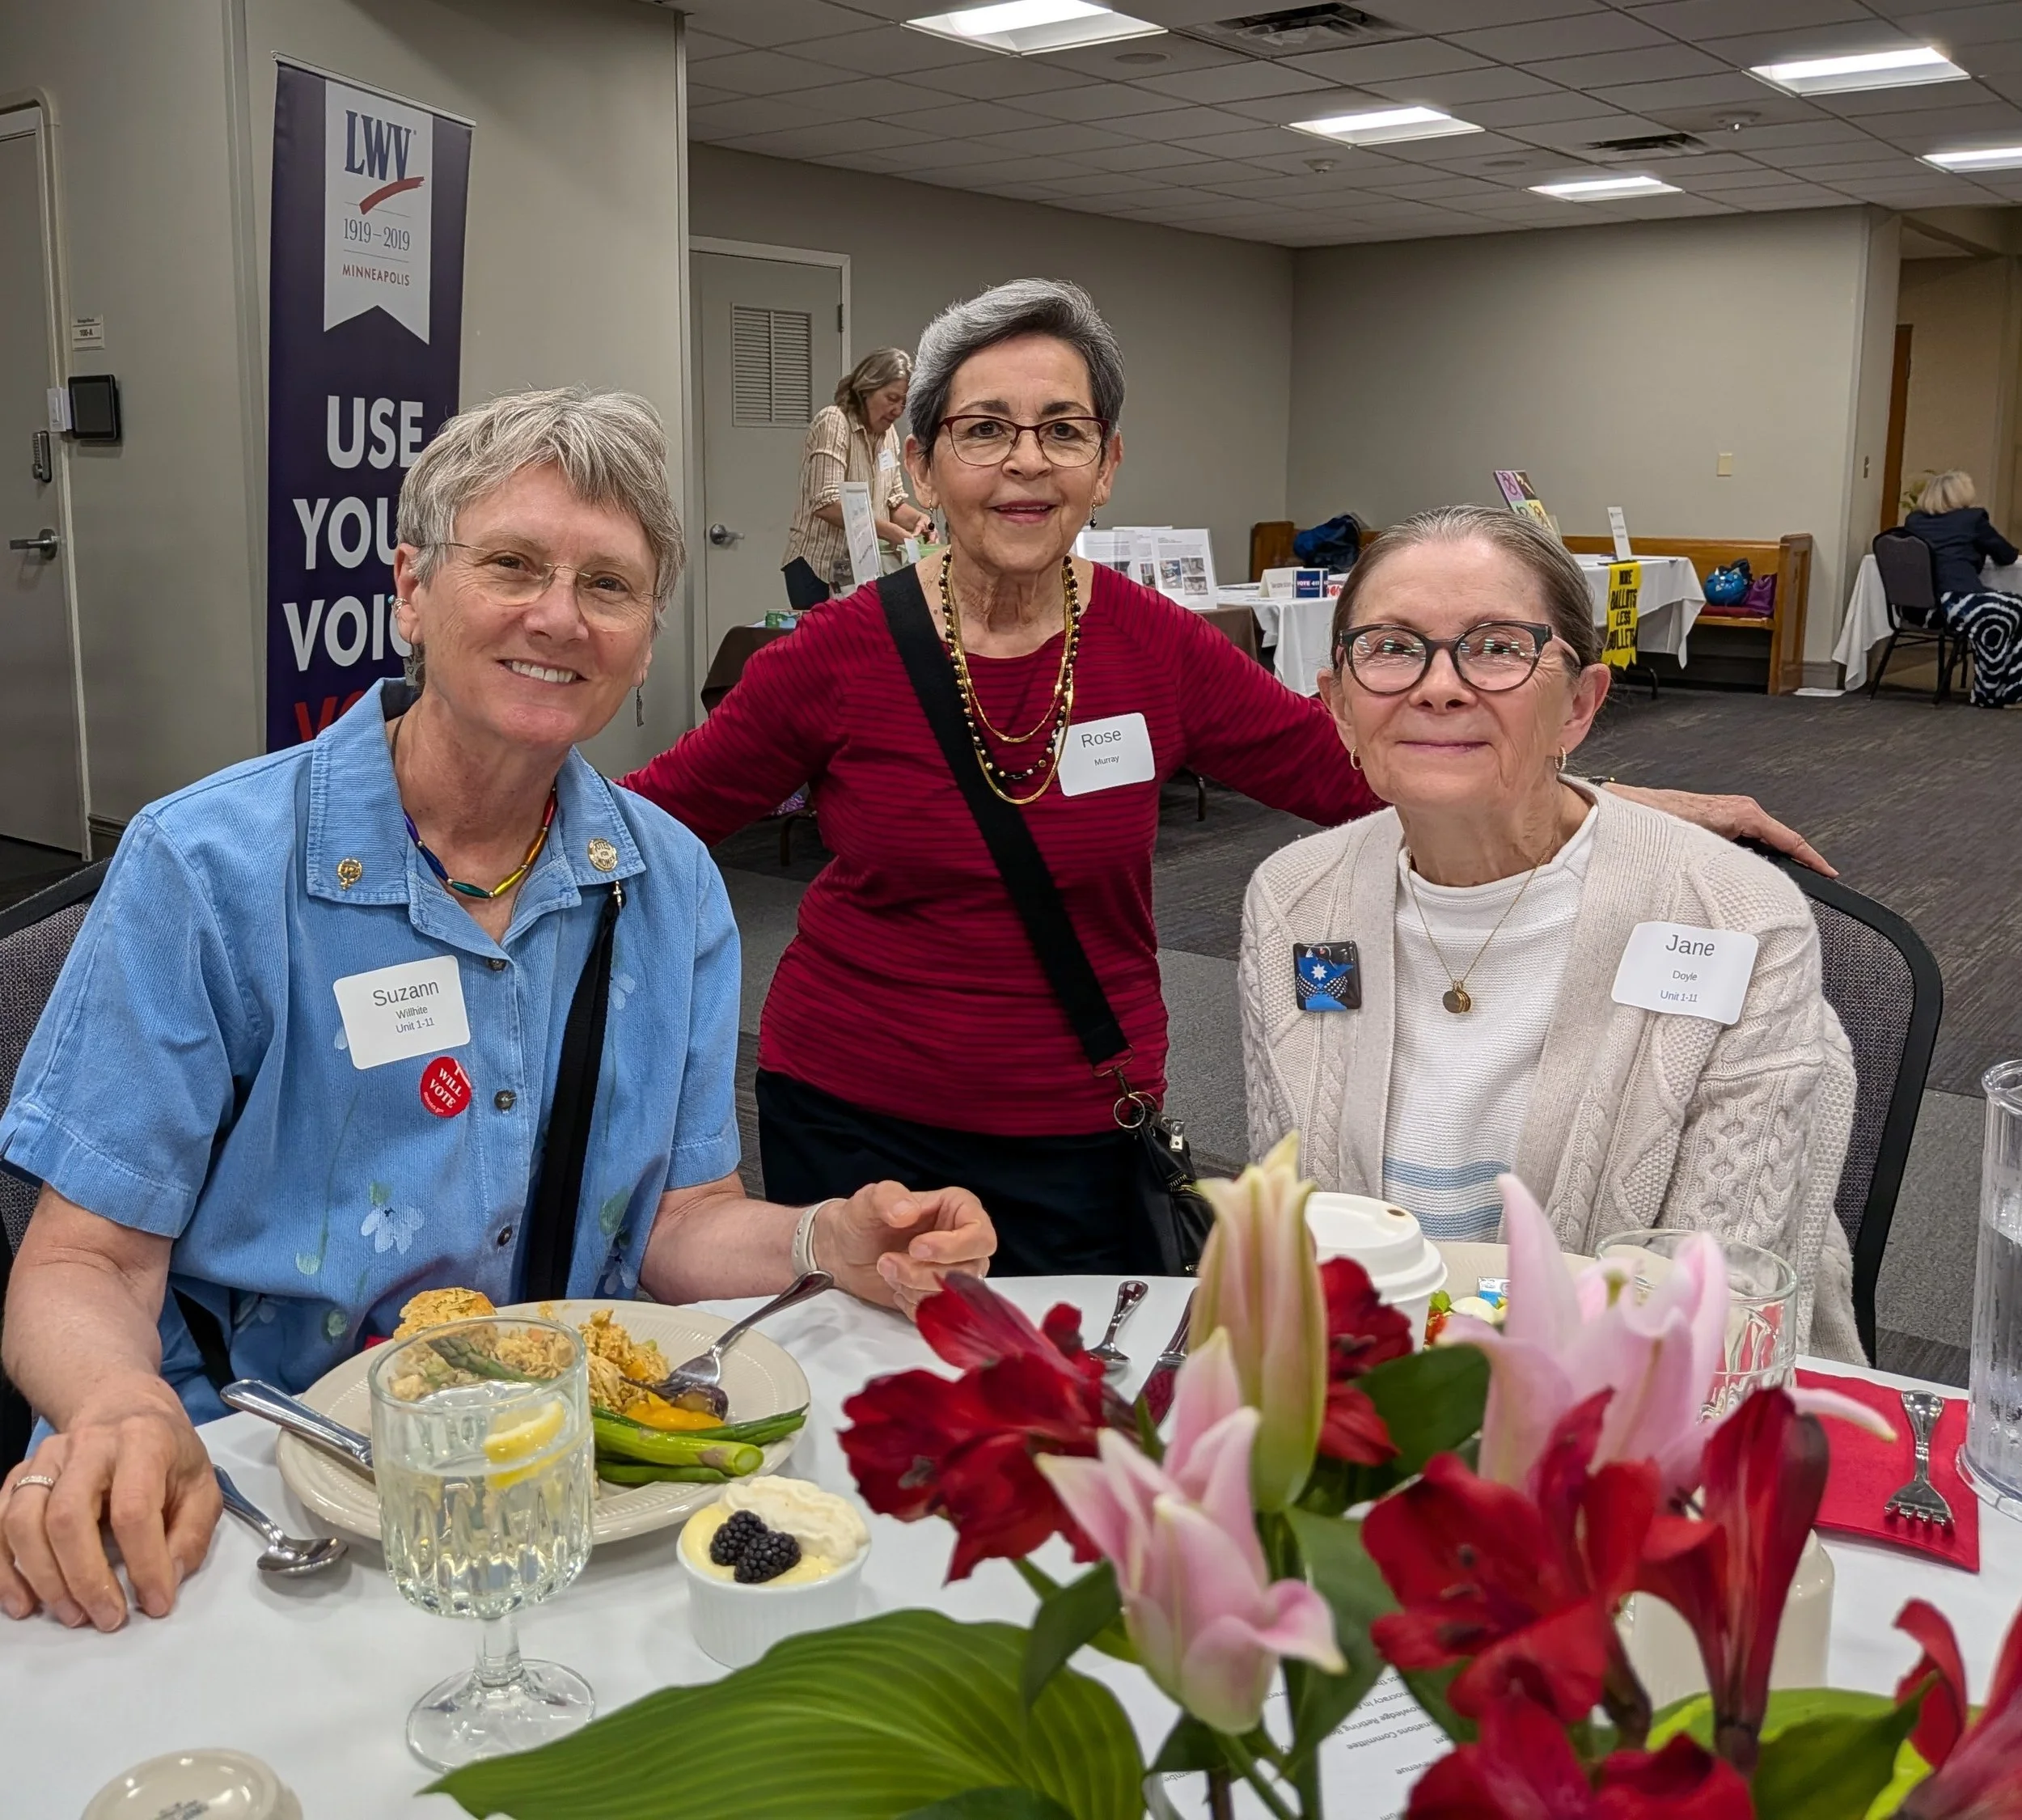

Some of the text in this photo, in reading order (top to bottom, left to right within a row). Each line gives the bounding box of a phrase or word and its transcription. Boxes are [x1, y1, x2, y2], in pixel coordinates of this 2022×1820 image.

[342, 264, 410, 286] MINNEAPOLIS
[327, 395, 423, 469] USE
[293, 496, 396, 570] YOU
[1616, 610, 1631, 627] LESS
[1081, 730, 1122, 748] Rose
[1094, 756, 1119, 766] Murray
[1665, 934, 1715, 956] Jane
[1672, 970, 1698, 983] Doyle
[372, 981, 440, 1007] Suzann
[1660, 989, 1698, 1003] Unit 1-11
[396, 1005, 428, 1019] Willhite
[396, 1017, 434, 1034] Unit 1-11
[439, 1067, 463, 1098] WILL
[429, 1077, 456, 1109] VOTE
[1342, 1717, 1381, 1733] Retiring
[1346, 1731, 1398, 1750] Committee
